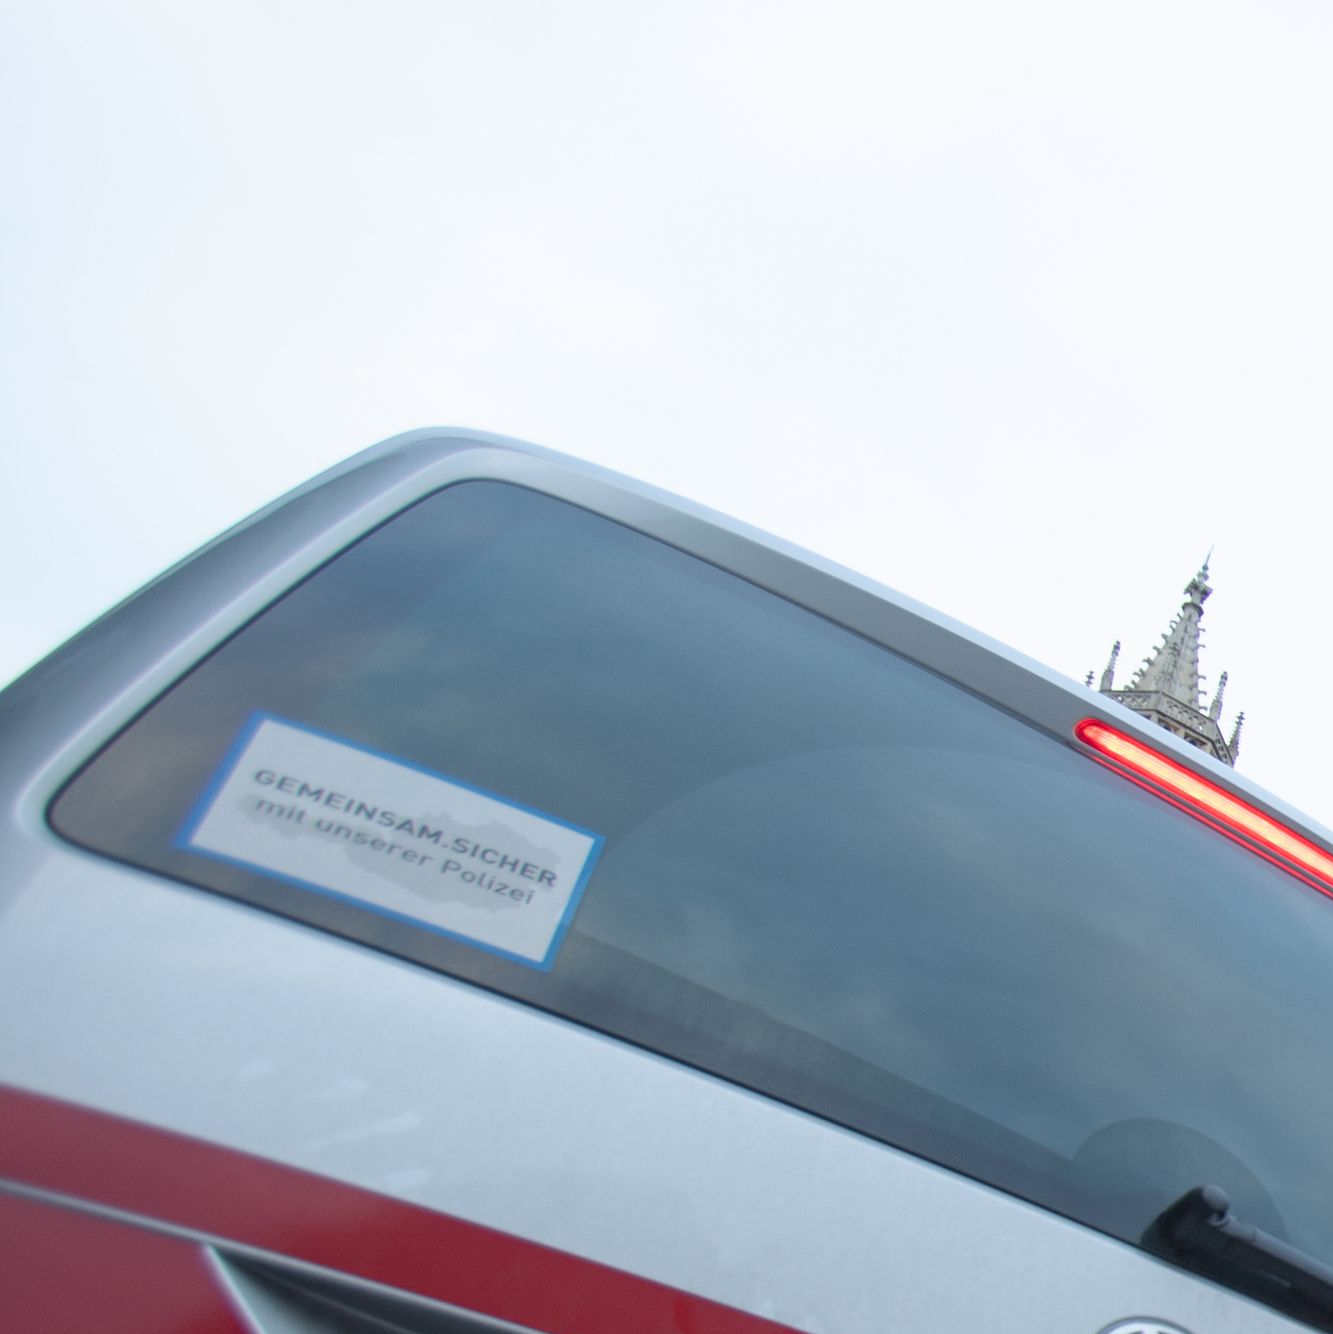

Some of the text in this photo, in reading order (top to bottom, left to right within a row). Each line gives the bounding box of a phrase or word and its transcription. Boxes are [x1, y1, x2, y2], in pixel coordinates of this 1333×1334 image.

[253, 768, 559, 889] GEMEINSAM.SICHER
[254, 797, 537, 906] mit unserer Polizei
